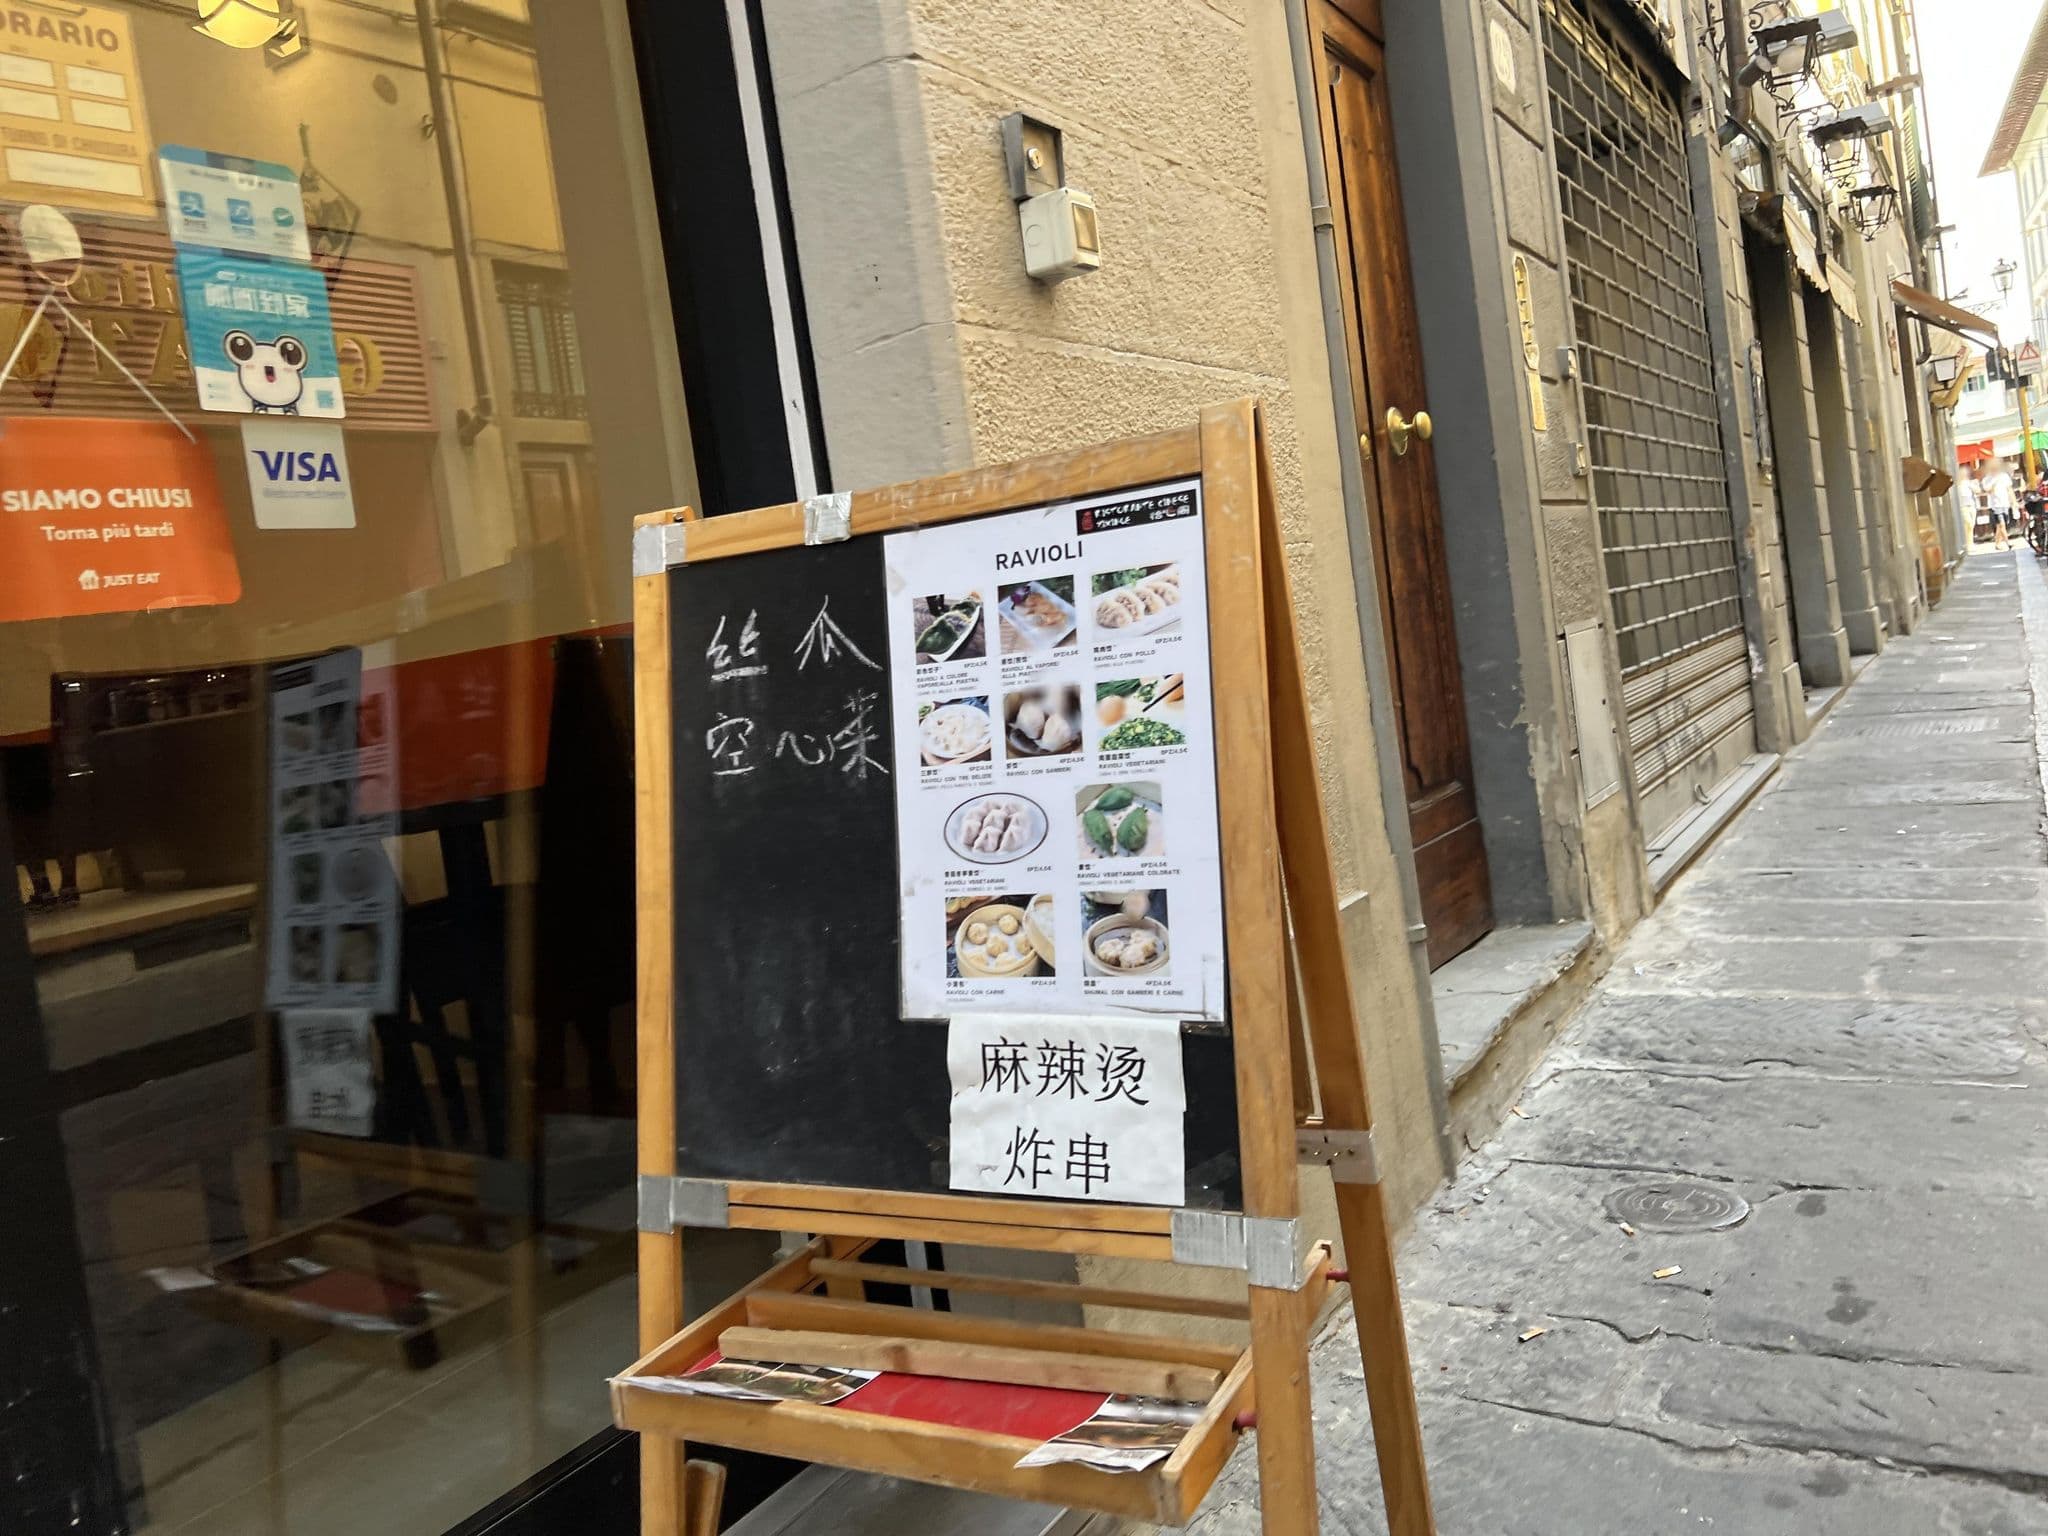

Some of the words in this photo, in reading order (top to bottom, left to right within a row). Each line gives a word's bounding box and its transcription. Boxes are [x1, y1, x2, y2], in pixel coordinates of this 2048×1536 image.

[251, 450, 341, 482] VISA
[2, 488, 102, 512] SIAMO
[107, 487, 193, 509] CHIUSI
[40, 525, 99, 542] Torna
[103, 524, 131, 542] più
[134, 522, 174, 538] tardi
[996, 540, 1084, 571] RAVIOLI
[103, 574, 134, 588] JUST
[136, 572, 160, 585] EAT
[980, 1036, 1150, 1106] 麻辣烫
[1003, 1126, 1111, 1195] 炸串
